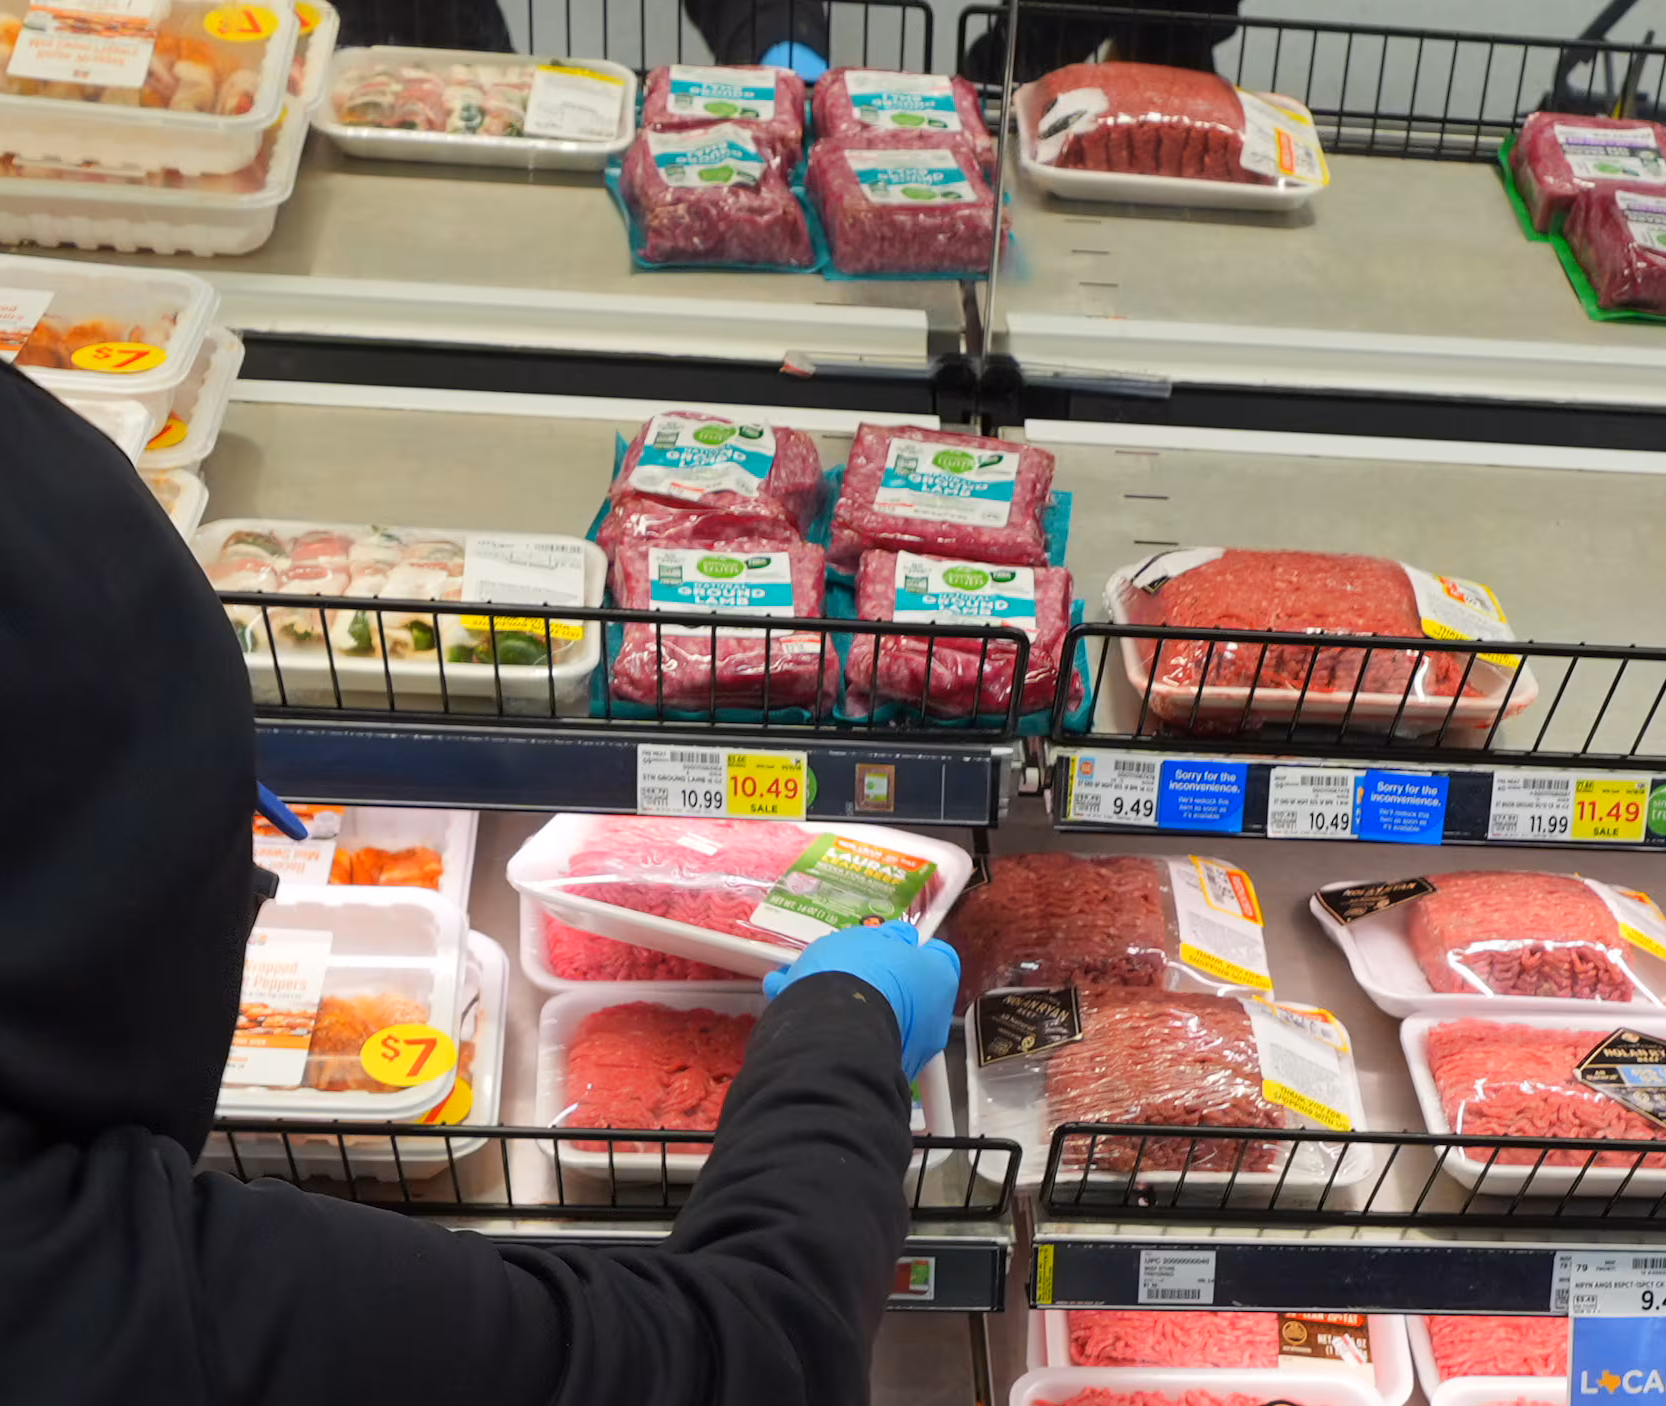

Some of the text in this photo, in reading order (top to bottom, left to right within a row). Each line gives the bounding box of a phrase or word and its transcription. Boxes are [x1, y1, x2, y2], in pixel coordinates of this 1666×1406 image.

[678, 586, 765, 599] GROUND
[1175, 769, 1237, 783] Sorry for the
[730, 776, 799, 799] 10.49
[1377, 781, 1438, 795] Sorry for the
[681, 789, 723, 809] 10.99
[1113, 797, 1154, 818] 9.49
[750, 804, 778, 814] SALE
[1576, 800, 1641, 822] 11.49
[1308, 811, 1350, 832] 10.49
[1529, 815, 1568, 834] 11.99
[1593, 827, 1619, 837] SALE
[380, 1035, 438, 1079] $7
